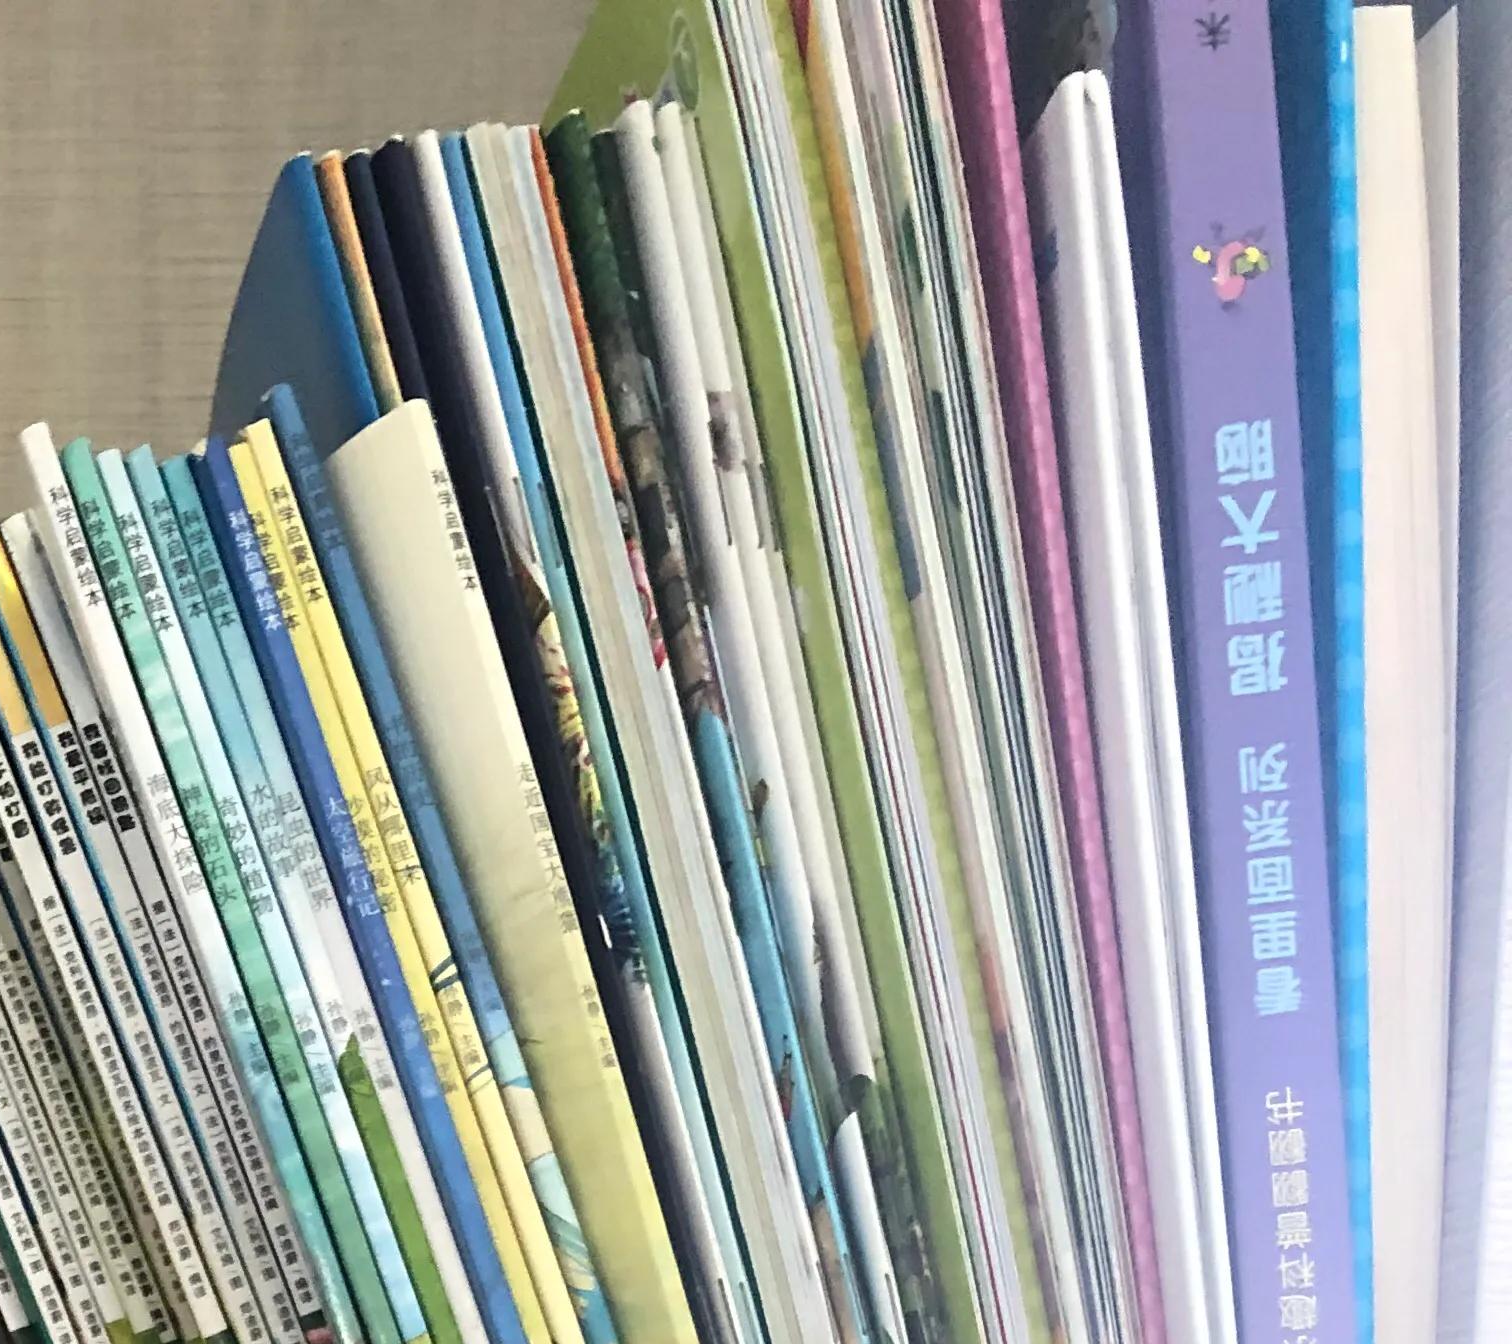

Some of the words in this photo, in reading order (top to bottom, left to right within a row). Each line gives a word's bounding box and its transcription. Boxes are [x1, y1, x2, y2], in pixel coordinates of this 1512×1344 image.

[1214, 416, 1294, 700] 揭秘大脑
[1238, 743, 1303, 1016] 看里面系列
